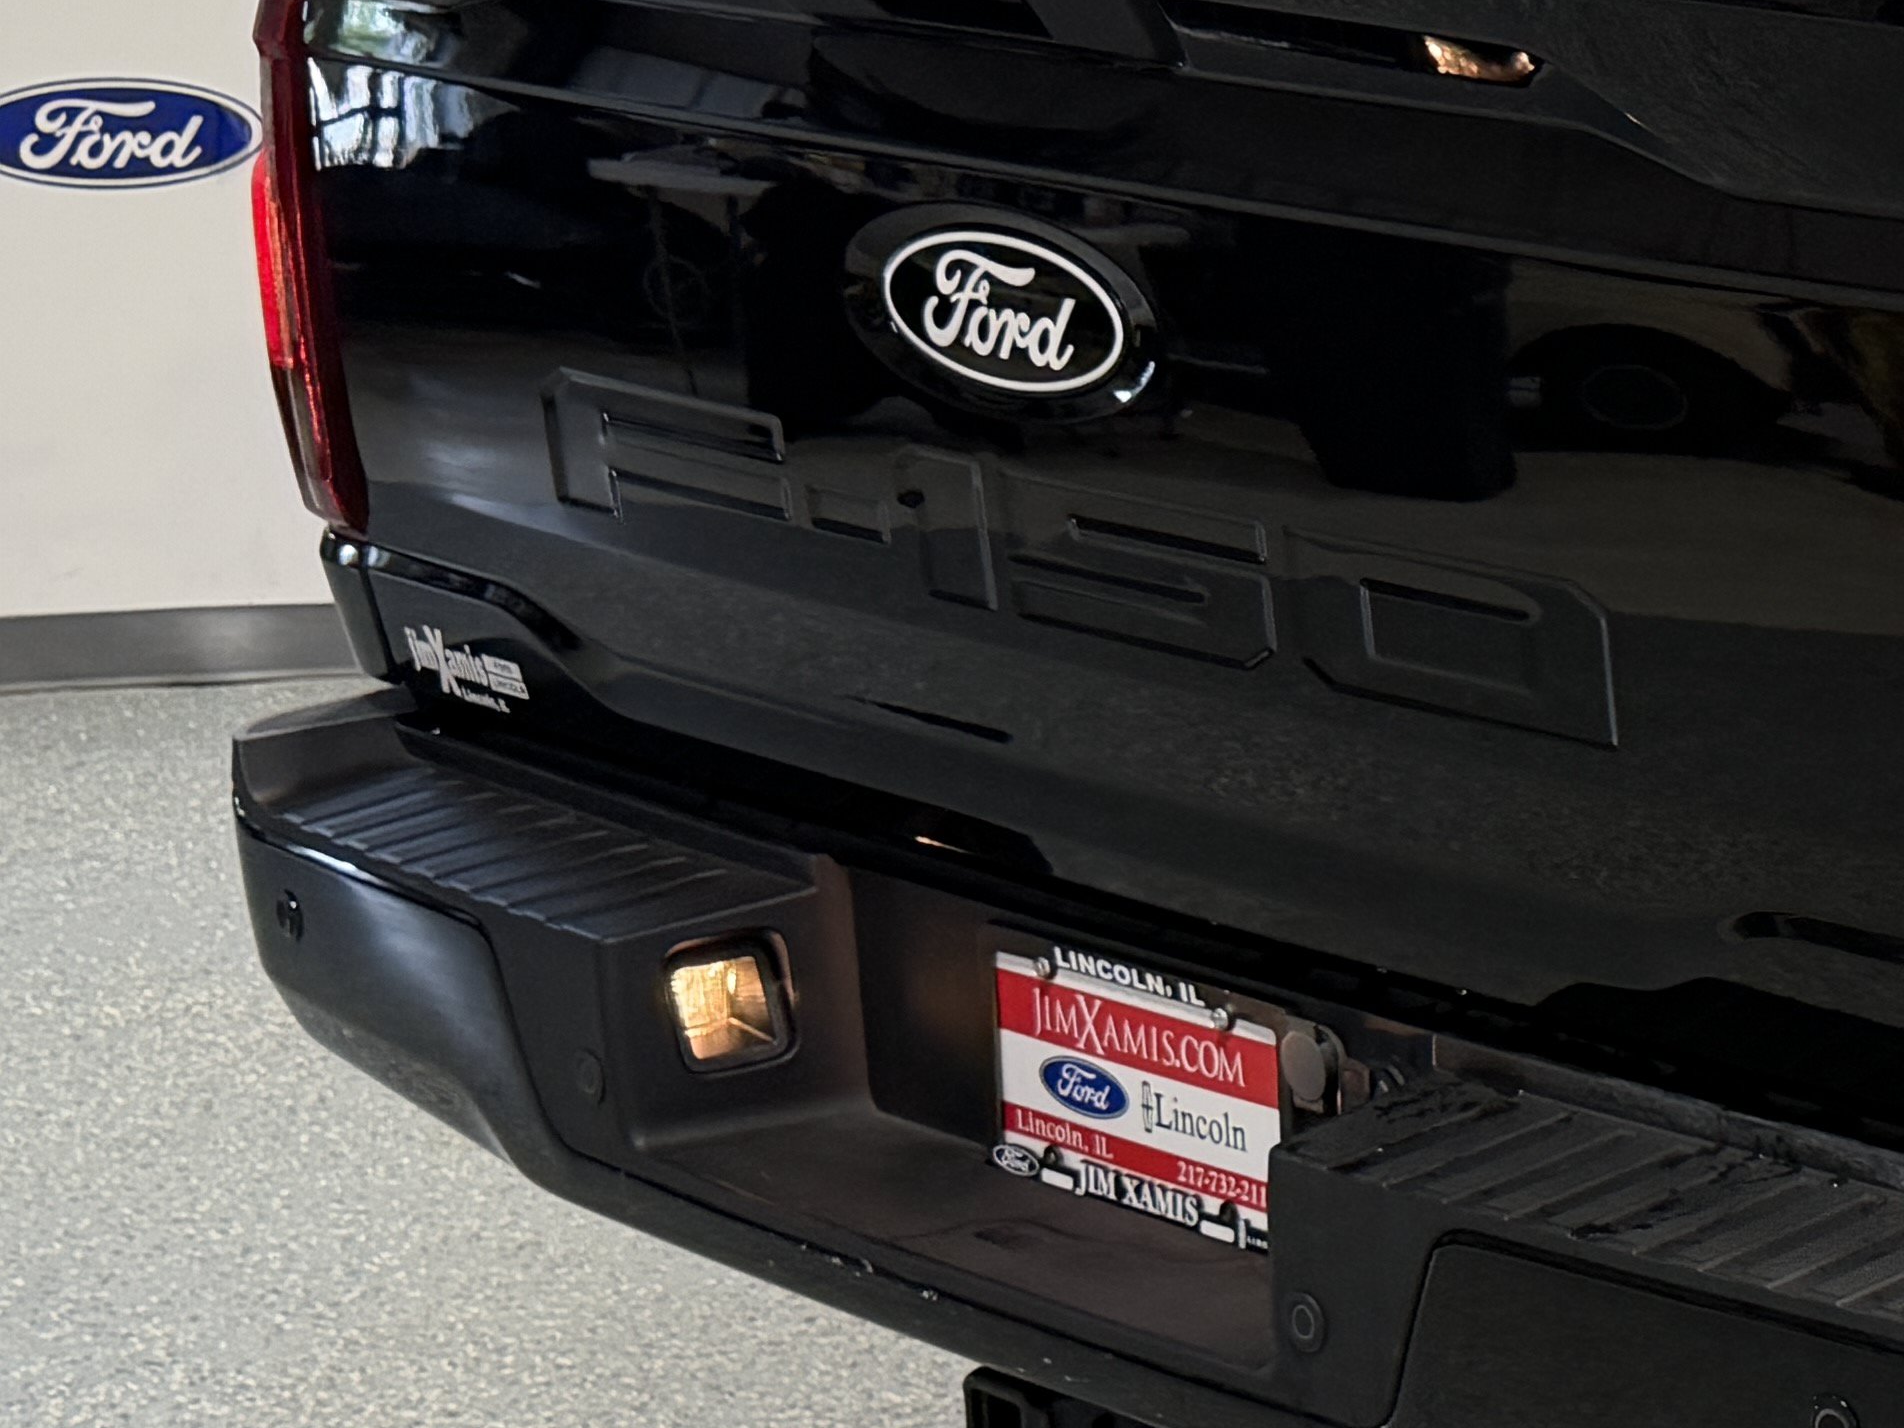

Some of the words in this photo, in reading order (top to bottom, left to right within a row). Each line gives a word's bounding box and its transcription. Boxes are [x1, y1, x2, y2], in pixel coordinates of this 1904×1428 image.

[19, 98, 204, 170] Ford
[923, 249, 1076, 371] Ford
[1053, 946, 1173, 998] LINCOLN,
[1179, 981, 1206, 1007] IL
[1032, 987, 1246, 1088] JIMXAMIS.COM
[1056, 1062, 1111, 1112] Ford
[1092, 1135, 1115, 1160] IL
[1155, 1093, 1248, 1152] Lincoln
[1075, 1162, 1117, 1198] JIM
[1121, 1175, 1200, 1228] XAMIS
[1176, 1160, 1267, 1206] 217-732-211
